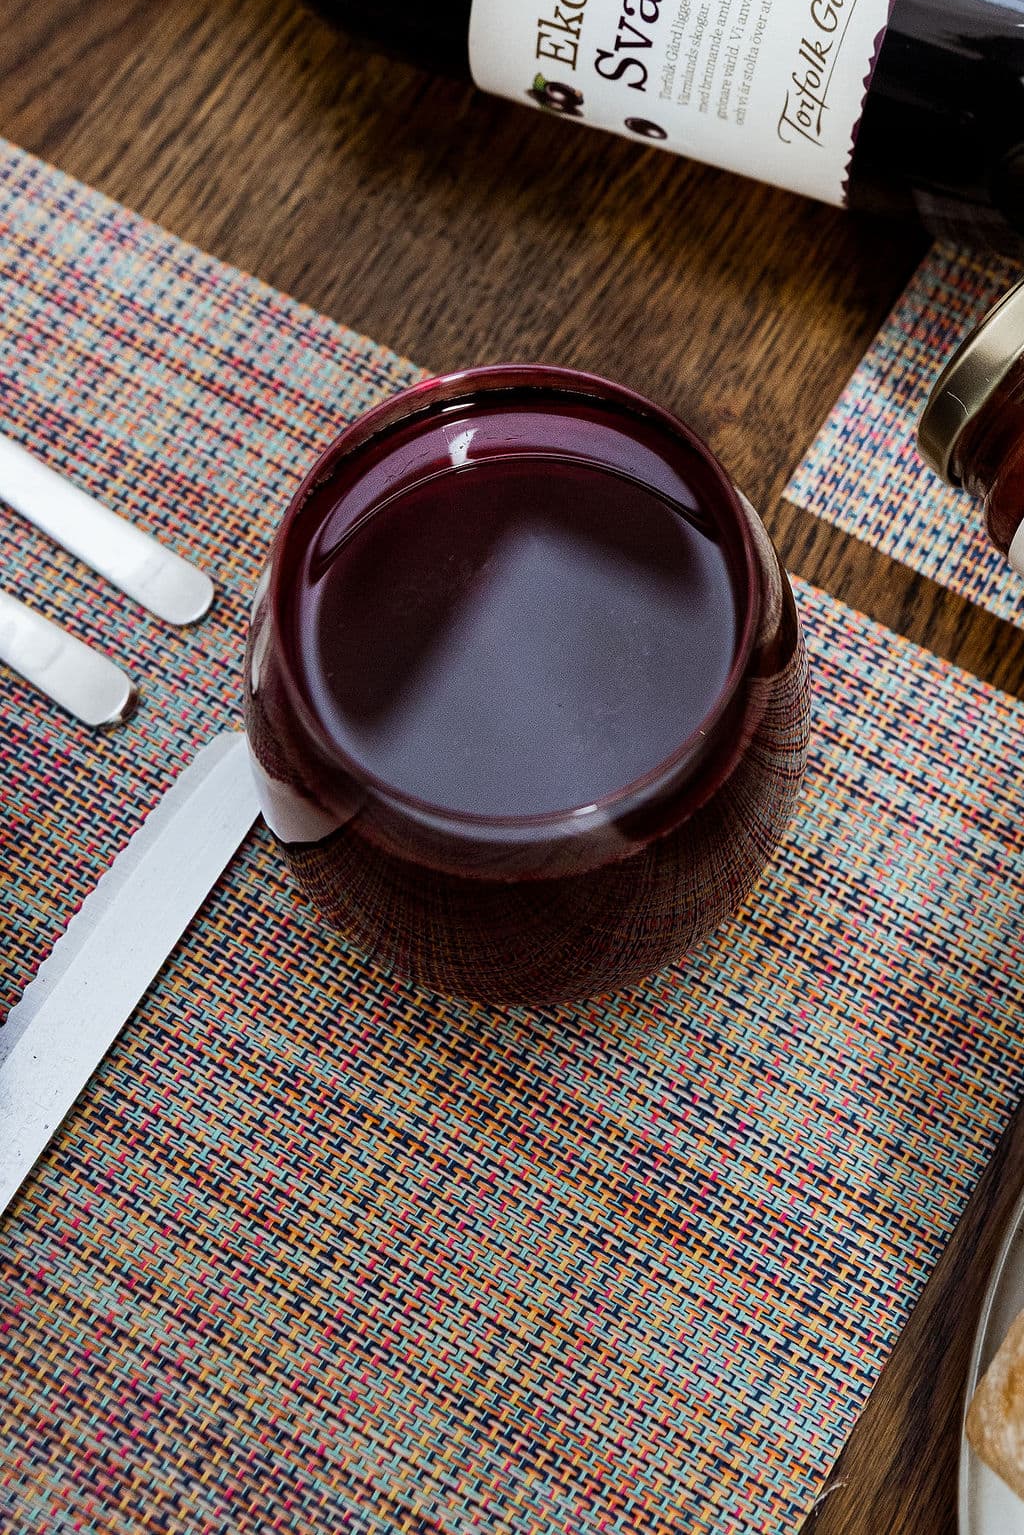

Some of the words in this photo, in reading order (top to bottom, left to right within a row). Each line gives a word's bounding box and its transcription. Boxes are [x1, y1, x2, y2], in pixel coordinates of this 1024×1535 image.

[689, 2, 712, 48] skogar.
[728, 25, 745, 41] Vi
[748, 13, 768, 46] över
[664, 29, 684, 62] Gård
[697, 27, 724, 91] brinnande
[723, 44, 741, 78] värld.
[742, 46, 760, 82] stolta
[716, 78, 732, 121] grönare
[737, 80, 752, 96] är
[737, 95, 749, 106] vi
[777, 38, 833, 146] Torfolk
[734, 107, 747, 127] och
